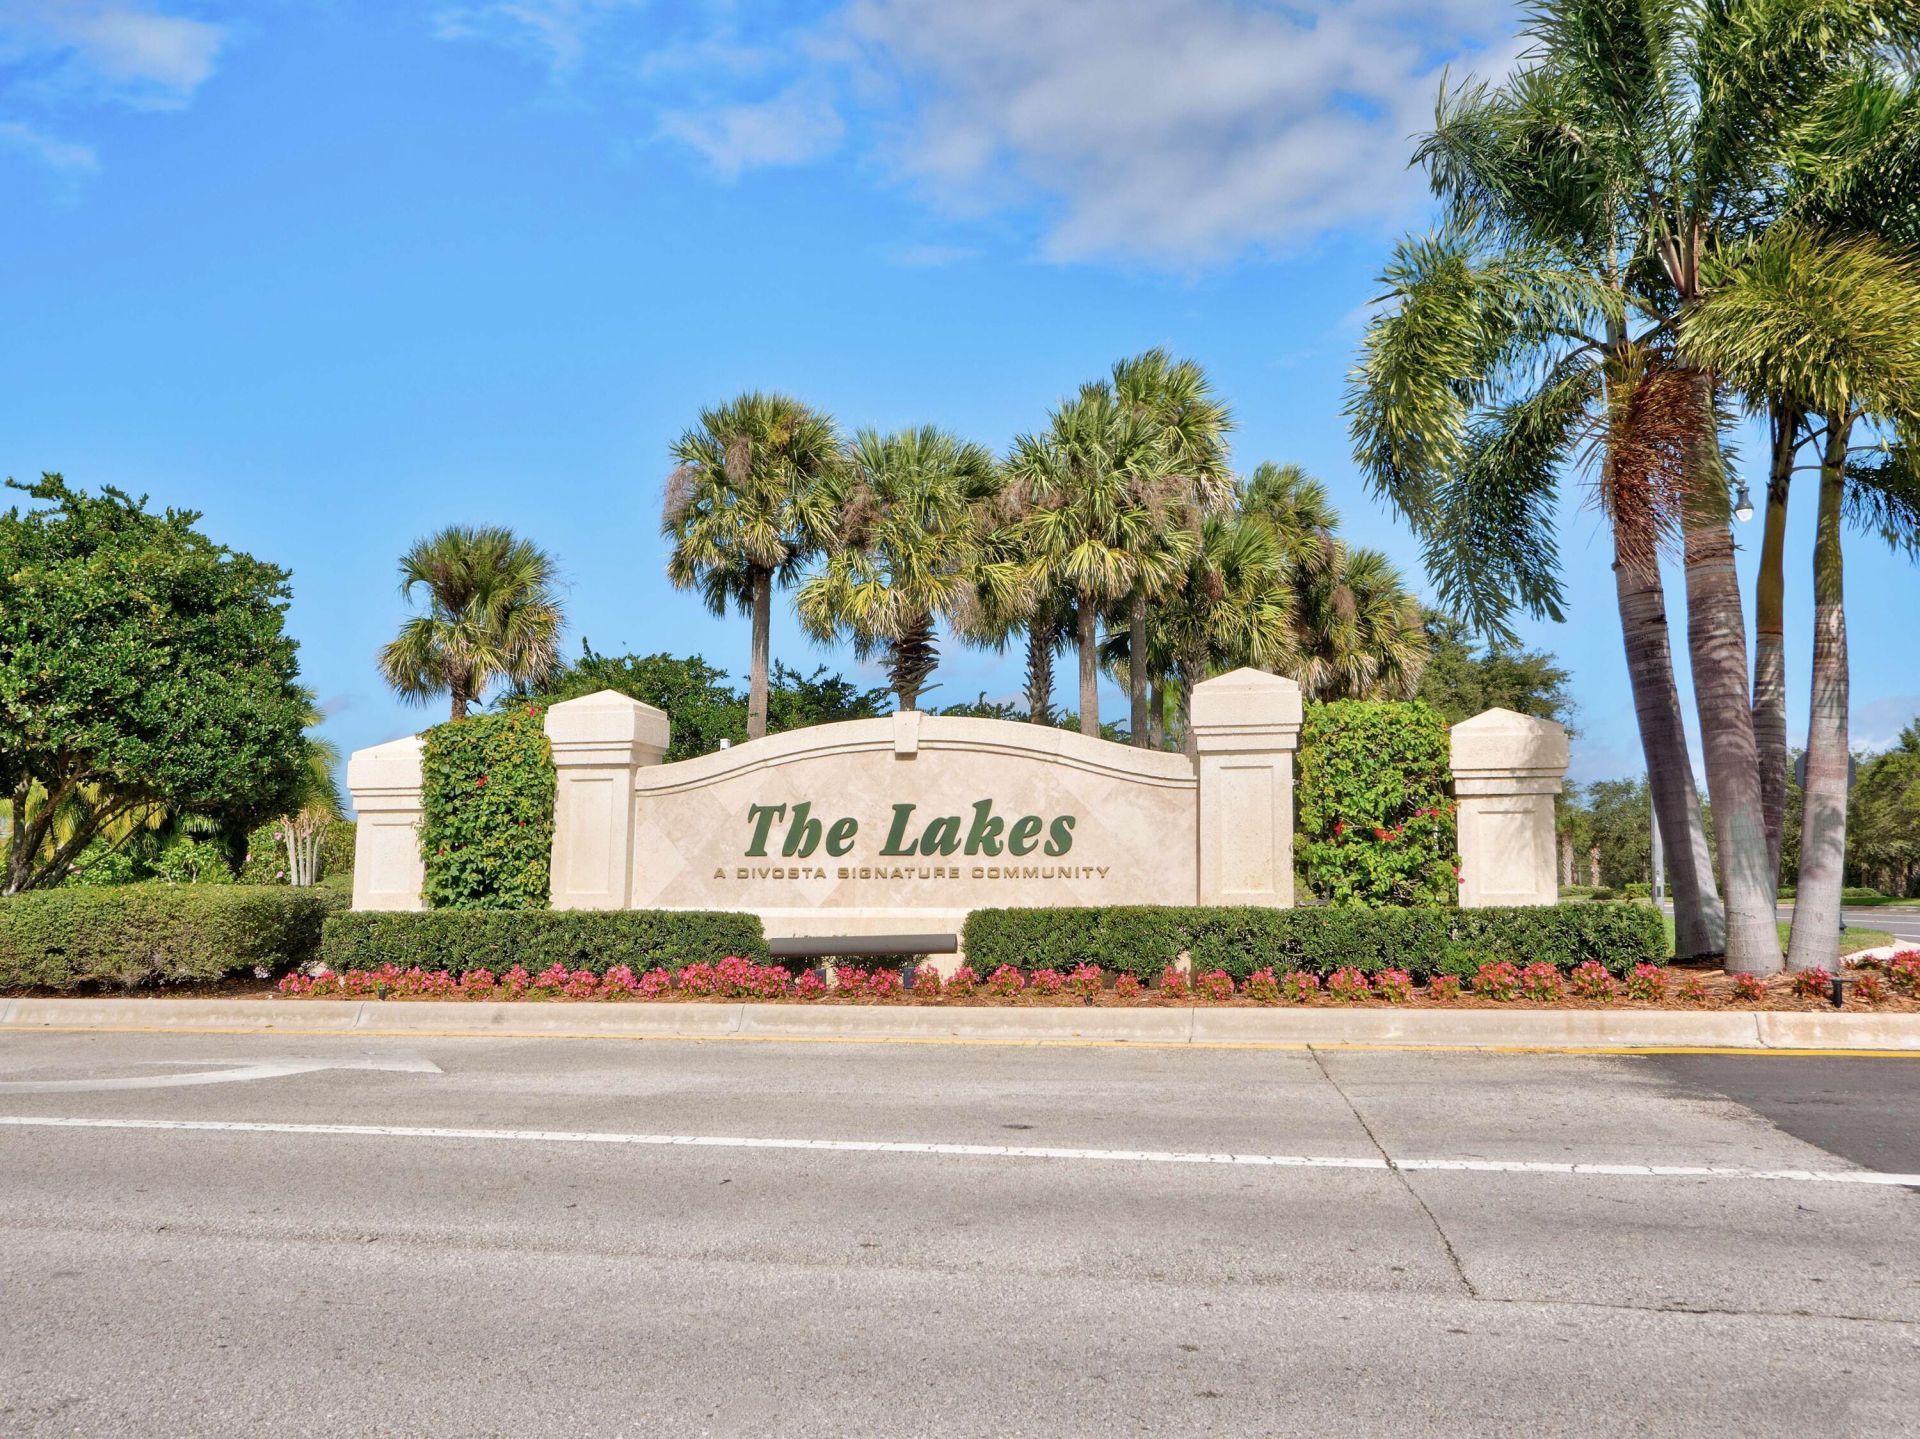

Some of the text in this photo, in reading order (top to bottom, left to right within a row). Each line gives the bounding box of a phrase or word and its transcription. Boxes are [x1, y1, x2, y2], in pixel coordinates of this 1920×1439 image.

[744, 798, 1076, 859] The Lakes
[713, 866, 1111, 880] A DIVOSTA SIGNATURE COMMUNITY
